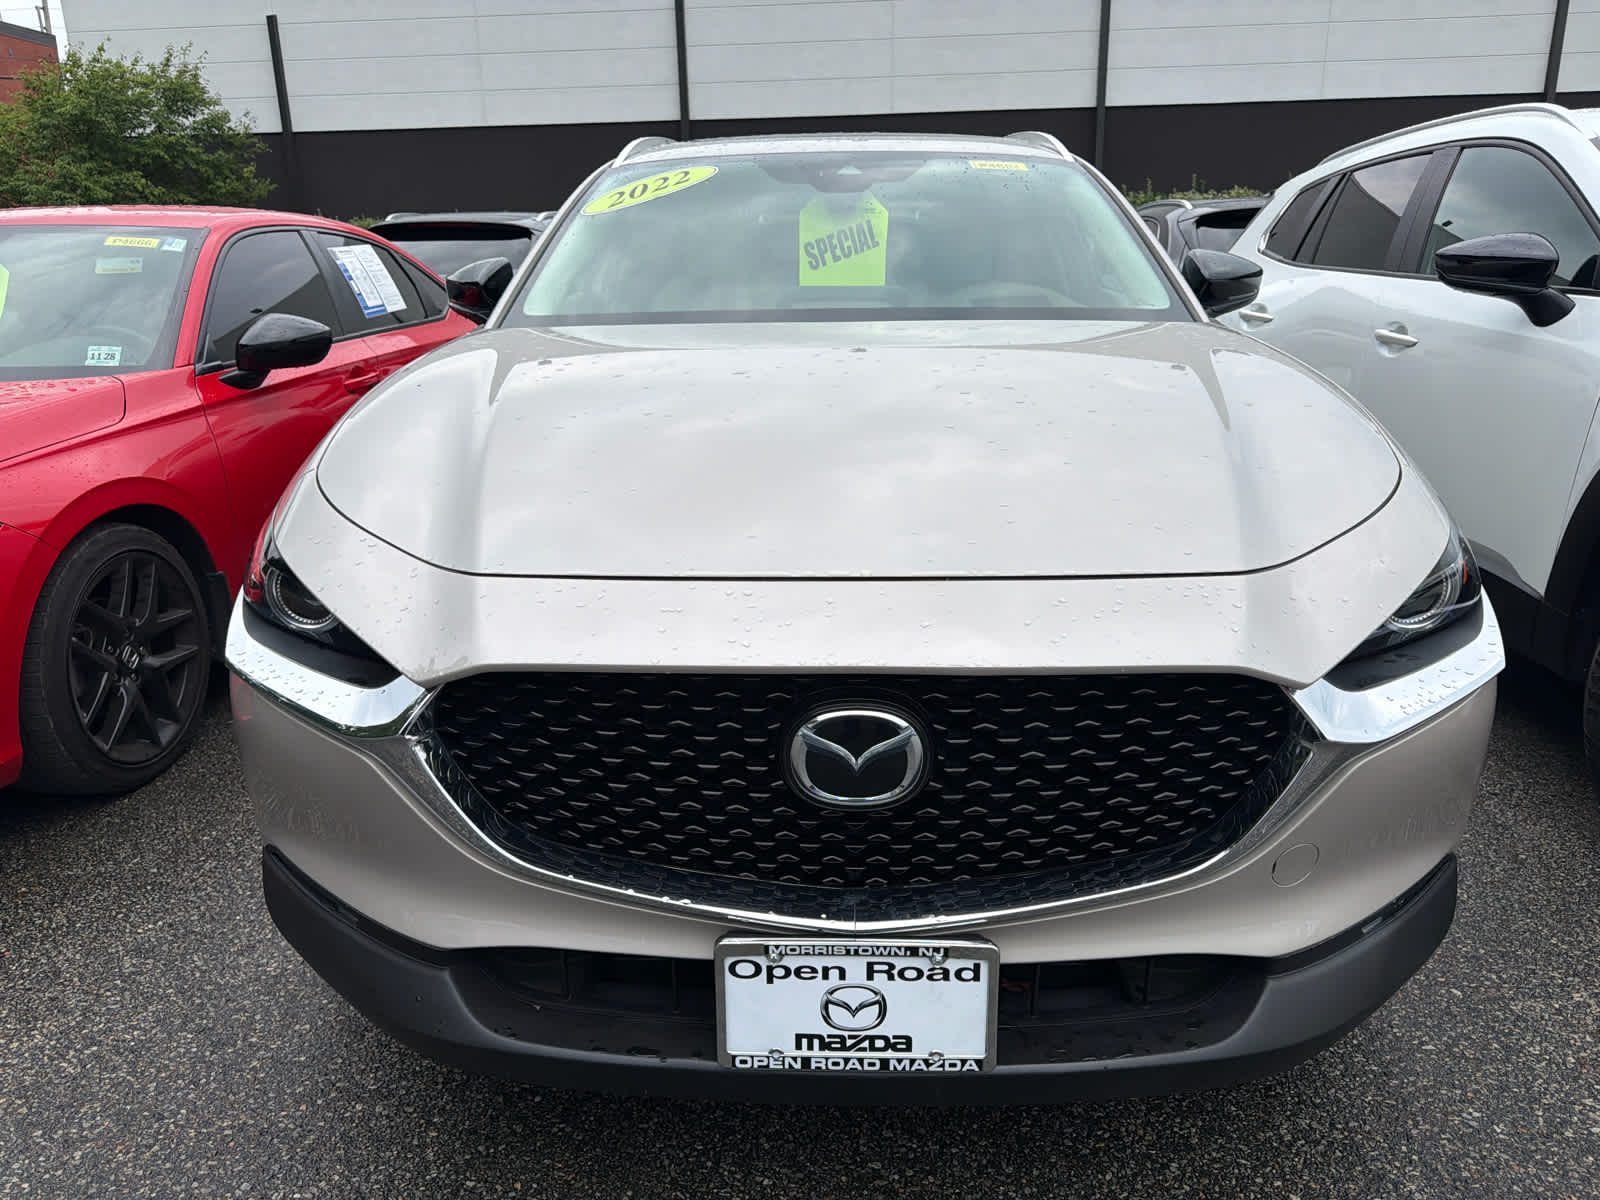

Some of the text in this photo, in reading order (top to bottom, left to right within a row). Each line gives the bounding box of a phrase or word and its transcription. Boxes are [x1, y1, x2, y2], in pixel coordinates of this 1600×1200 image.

[607, 170, 691, 208] 2022
[803, 219, 880, 271] SPECIAL
[768, 945, 946, 957] MORRISTOWN, NJ
[727, 958, 981, 985] Open Road
[734, 1055, 980, 1072] OPEN ROAD MAZDA
